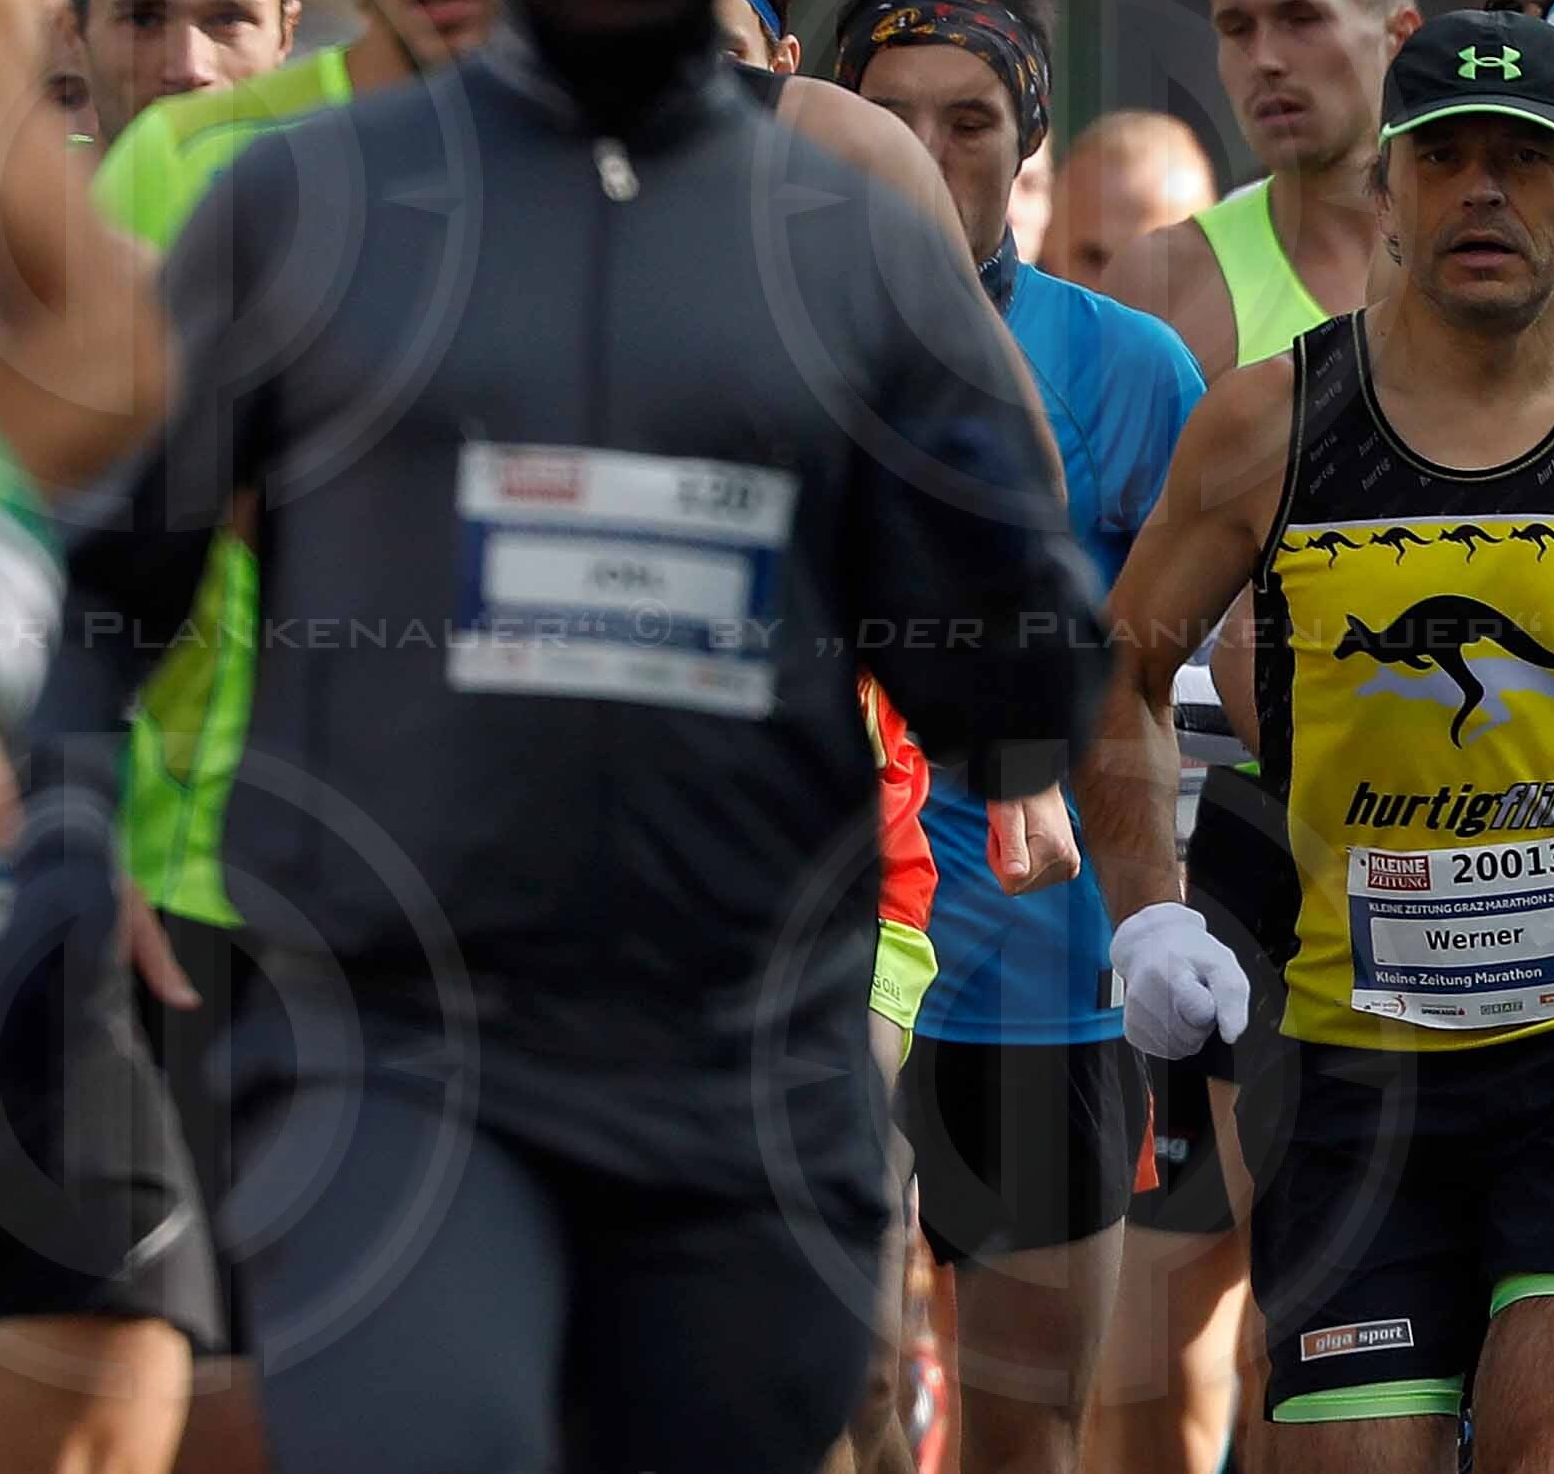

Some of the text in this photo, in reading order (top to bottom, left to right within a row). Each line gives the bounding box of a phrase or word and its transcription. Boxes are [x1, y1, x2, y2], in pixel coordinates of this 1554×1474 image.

[1371, 856, 1427, 874] KLEINE
[1370, 876, 1428, 889] ZEITUNG
[1369, 902, 1404, 915] KLEINE
[1404, 902, 1452, 915] ZEITUNG
[1453, 901, 1484, 913] GRAZ
[1485, 893, 1547, 912] MARATHON
[1425, 927, 1525, 951] Werner
[1375, 965, 1543, 988] Kleine Zeitung Marathon
[1315, 1325, 1404, 1353] giga sport
